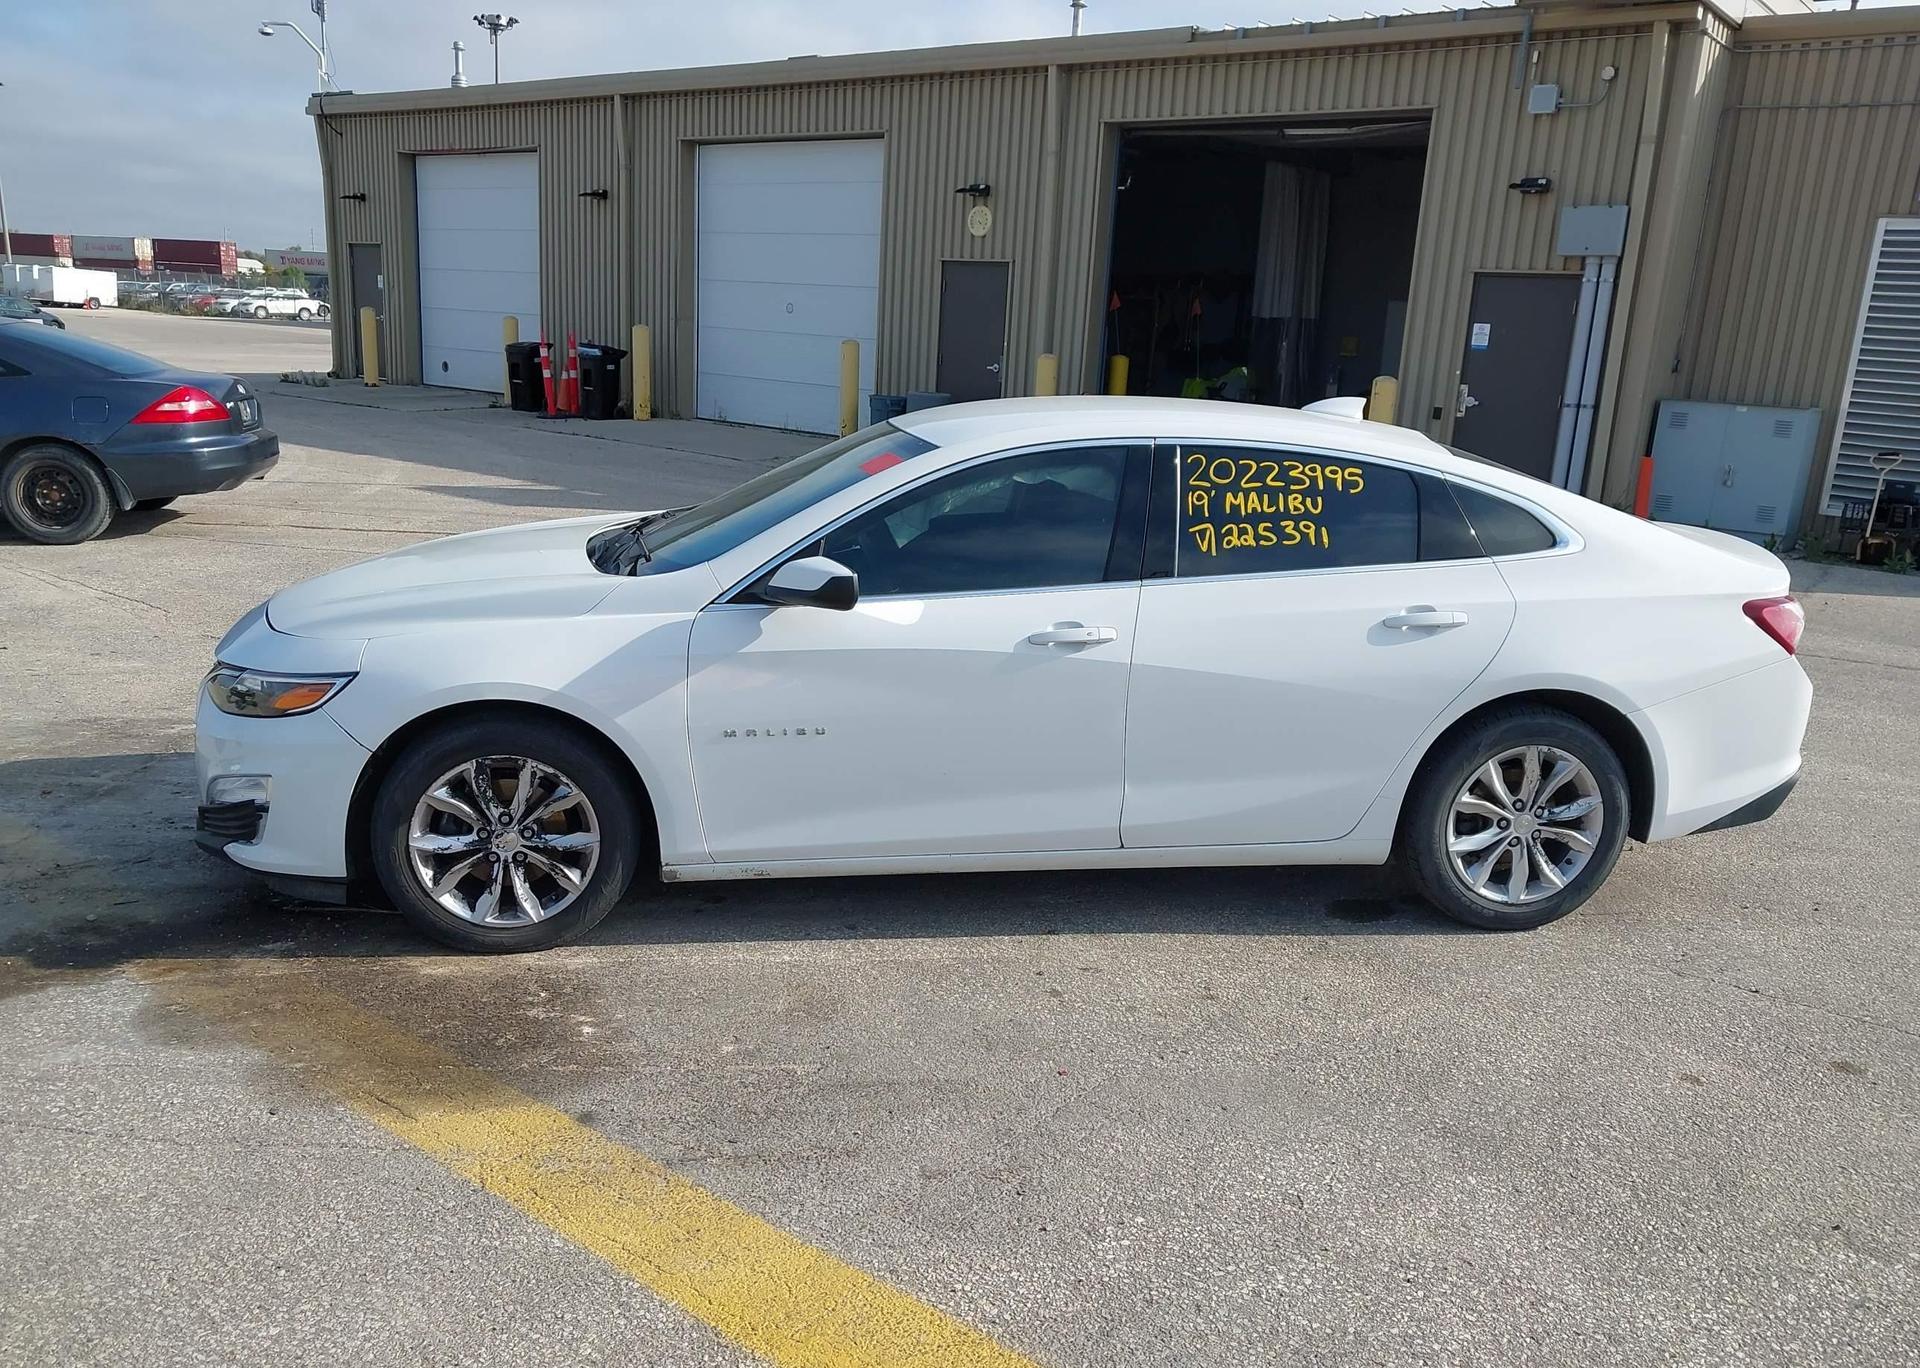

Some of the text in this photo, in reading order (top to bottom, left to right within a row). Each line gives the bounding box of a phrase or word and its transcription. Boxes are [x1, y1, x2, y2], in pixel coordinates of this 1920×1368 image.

[287, 255, 305, 266] YANG
[1187, 454, 1365, 494] 20223995
[1188, 489, 1323, 518] 19' MALIBU
[723, 727, 826, 738] MALIBU
